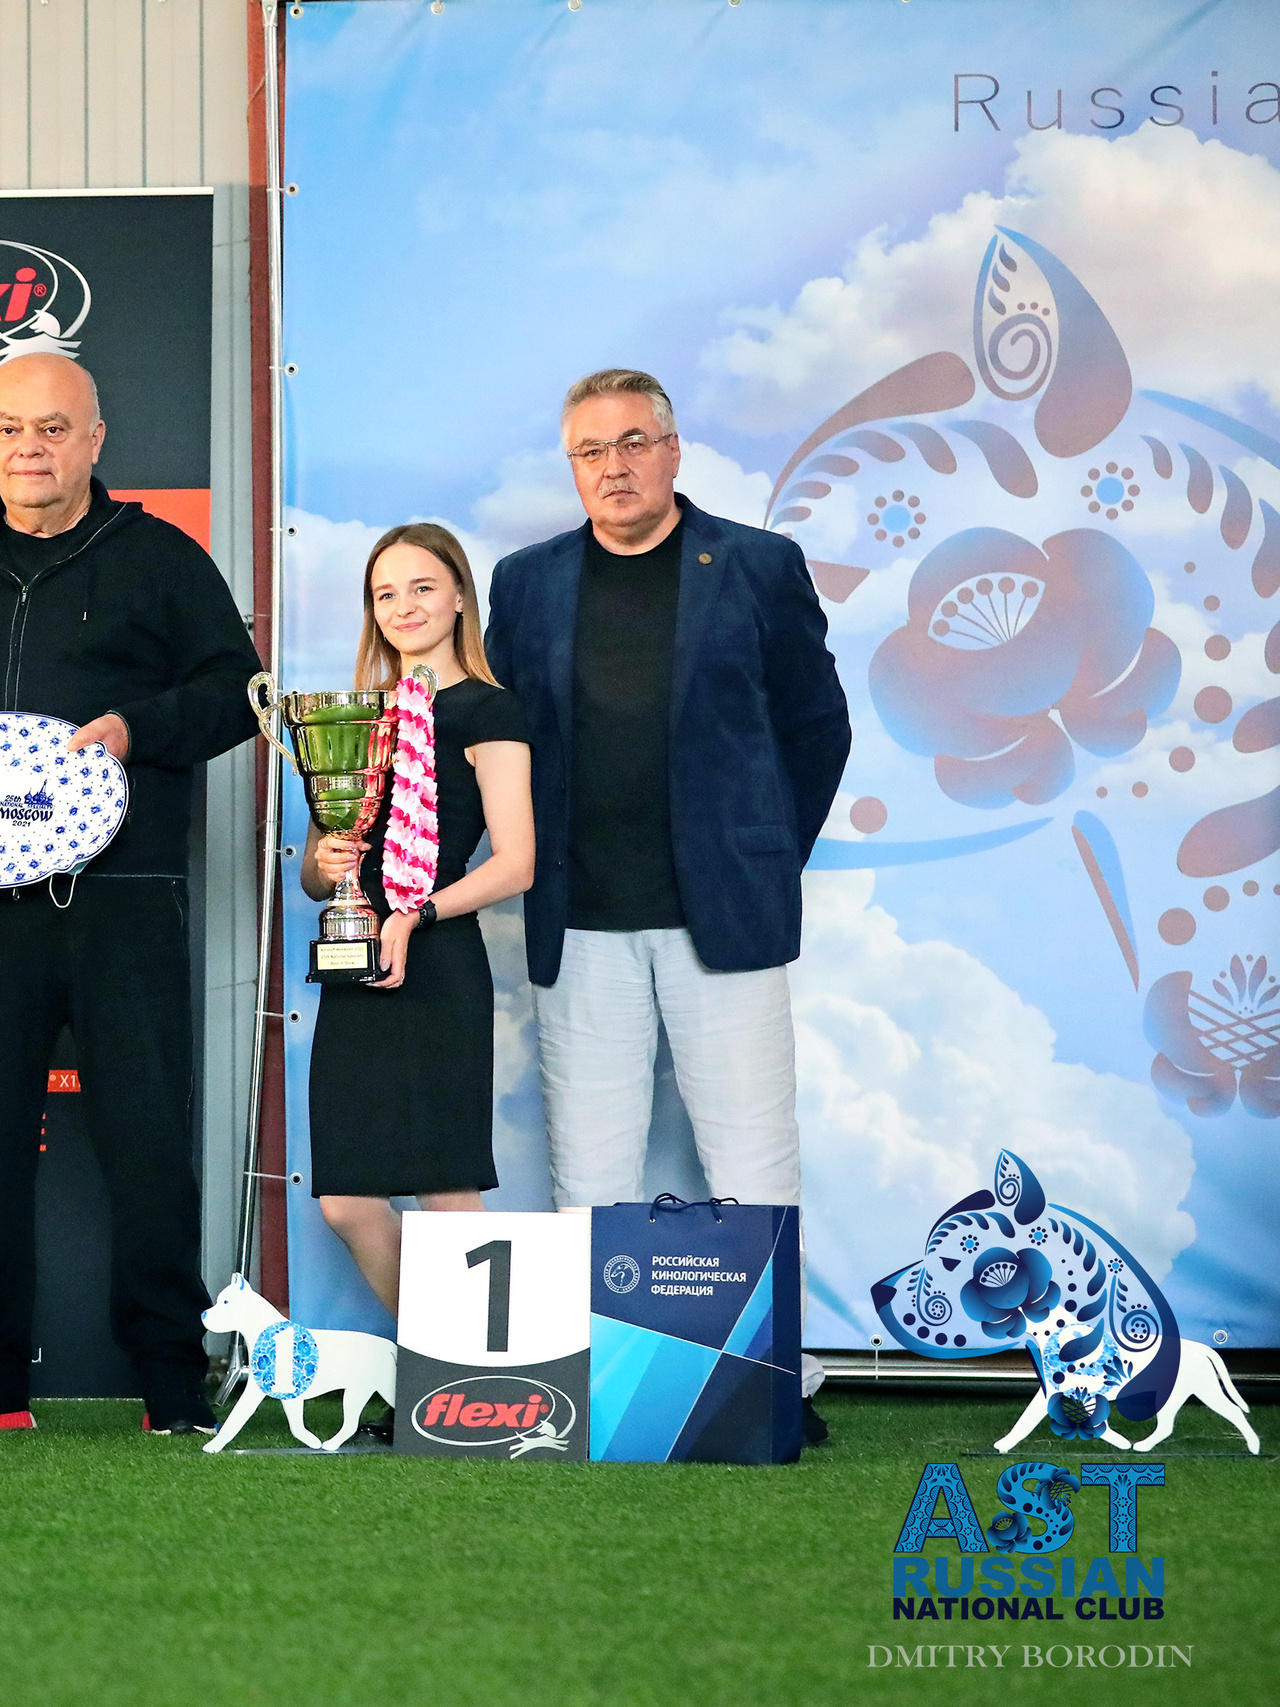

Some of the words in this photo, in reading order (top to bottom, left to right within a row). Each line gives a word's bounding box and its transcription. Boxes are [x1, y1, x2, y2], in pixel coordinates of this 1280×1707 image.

[652, 1254, 720, 1268] РОССИЙСКАЯ
[651, 1270, 747, 1283] КИНОЛОГИЧЕСКАЯ
[464, 1239, 512, 1353] 1
[651, 1284, 714, 1296] ФЕДЕРАЦИЯ
